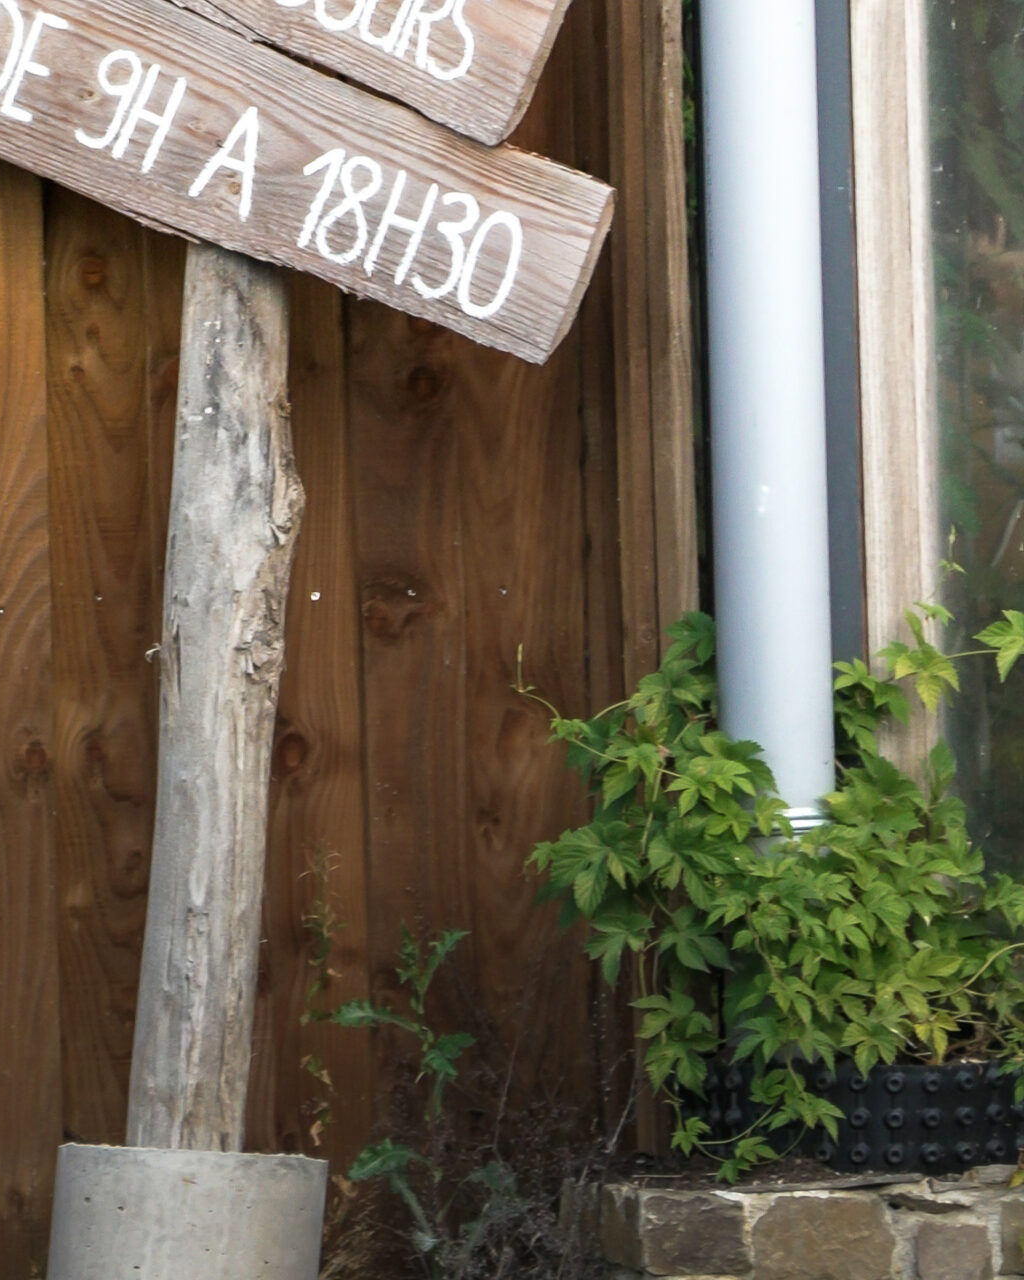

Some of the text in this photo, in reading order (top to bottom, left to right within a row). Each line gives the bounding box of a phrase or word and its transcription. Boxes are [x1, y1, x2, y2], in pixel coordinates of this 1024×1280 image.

[75, 48, 187, 175] 9H
[188, 106, 260, 221] A
[301, 147, 524, 320] 18H30
